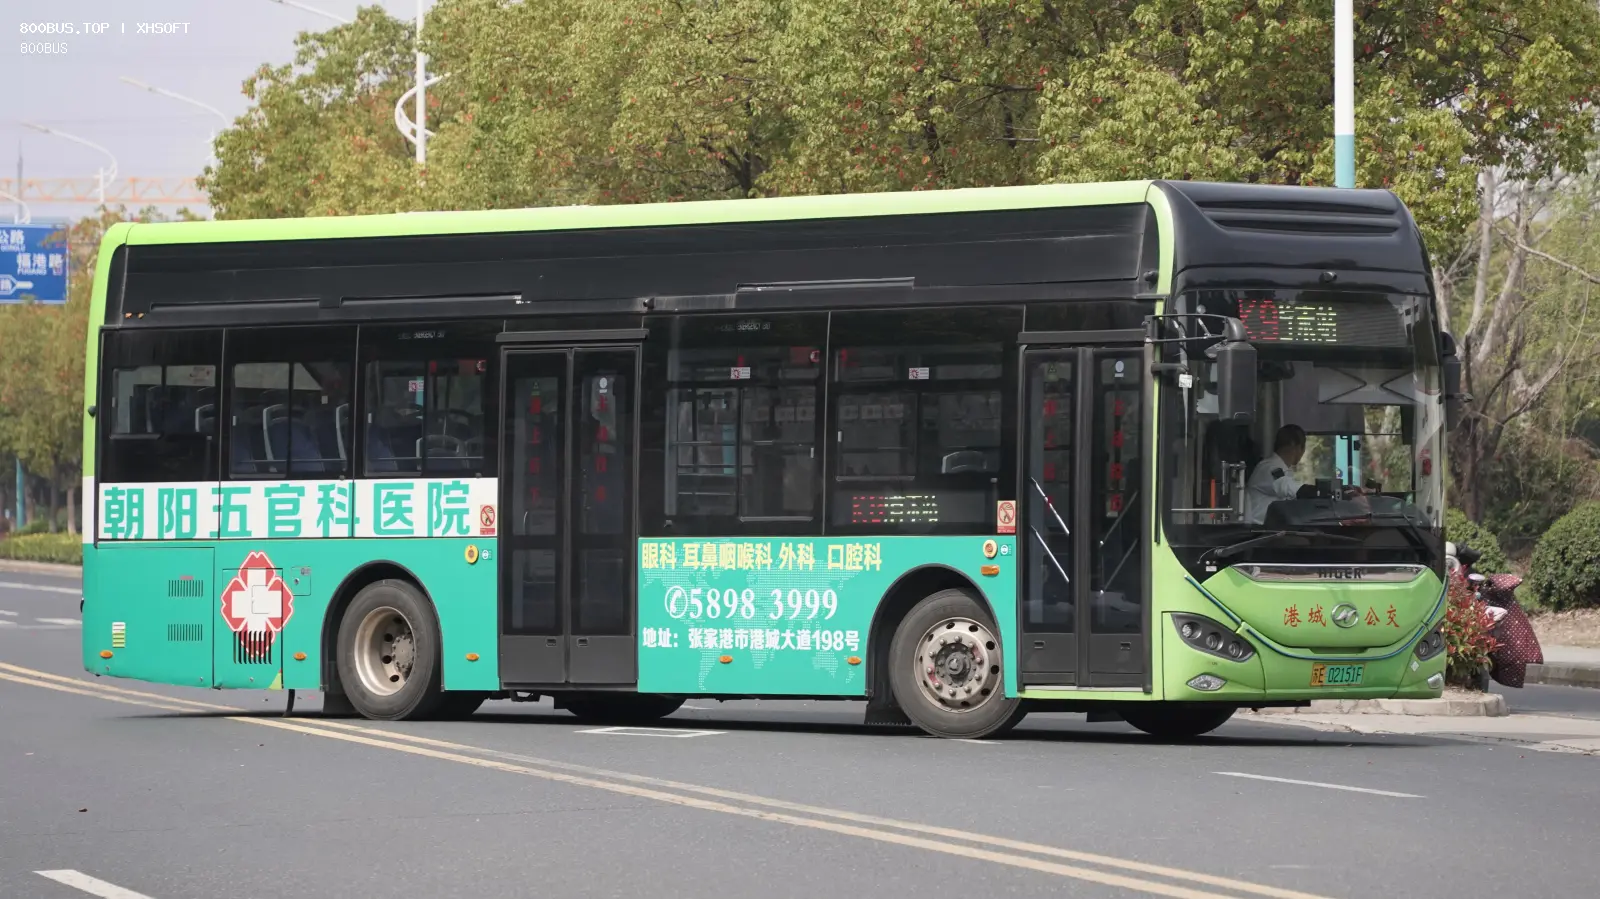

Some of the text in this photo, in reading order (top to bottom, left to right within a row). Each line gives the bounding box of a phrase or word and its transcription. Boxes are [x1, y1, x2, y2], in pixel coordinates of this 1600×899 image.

[103, 480, 471, 540] 朝阳五官科医院
[641, 542, 883, 572] 眼科 耳鼻咽喉科 外科 口腔科
[1318, 567, 1362, 579] HIGER
[689, 587, 839, 621] 5898 3999
[1283, 603, 1400, 628] 港城 公交
[688, 627, 861, 652] 张家港市港城大道198号
